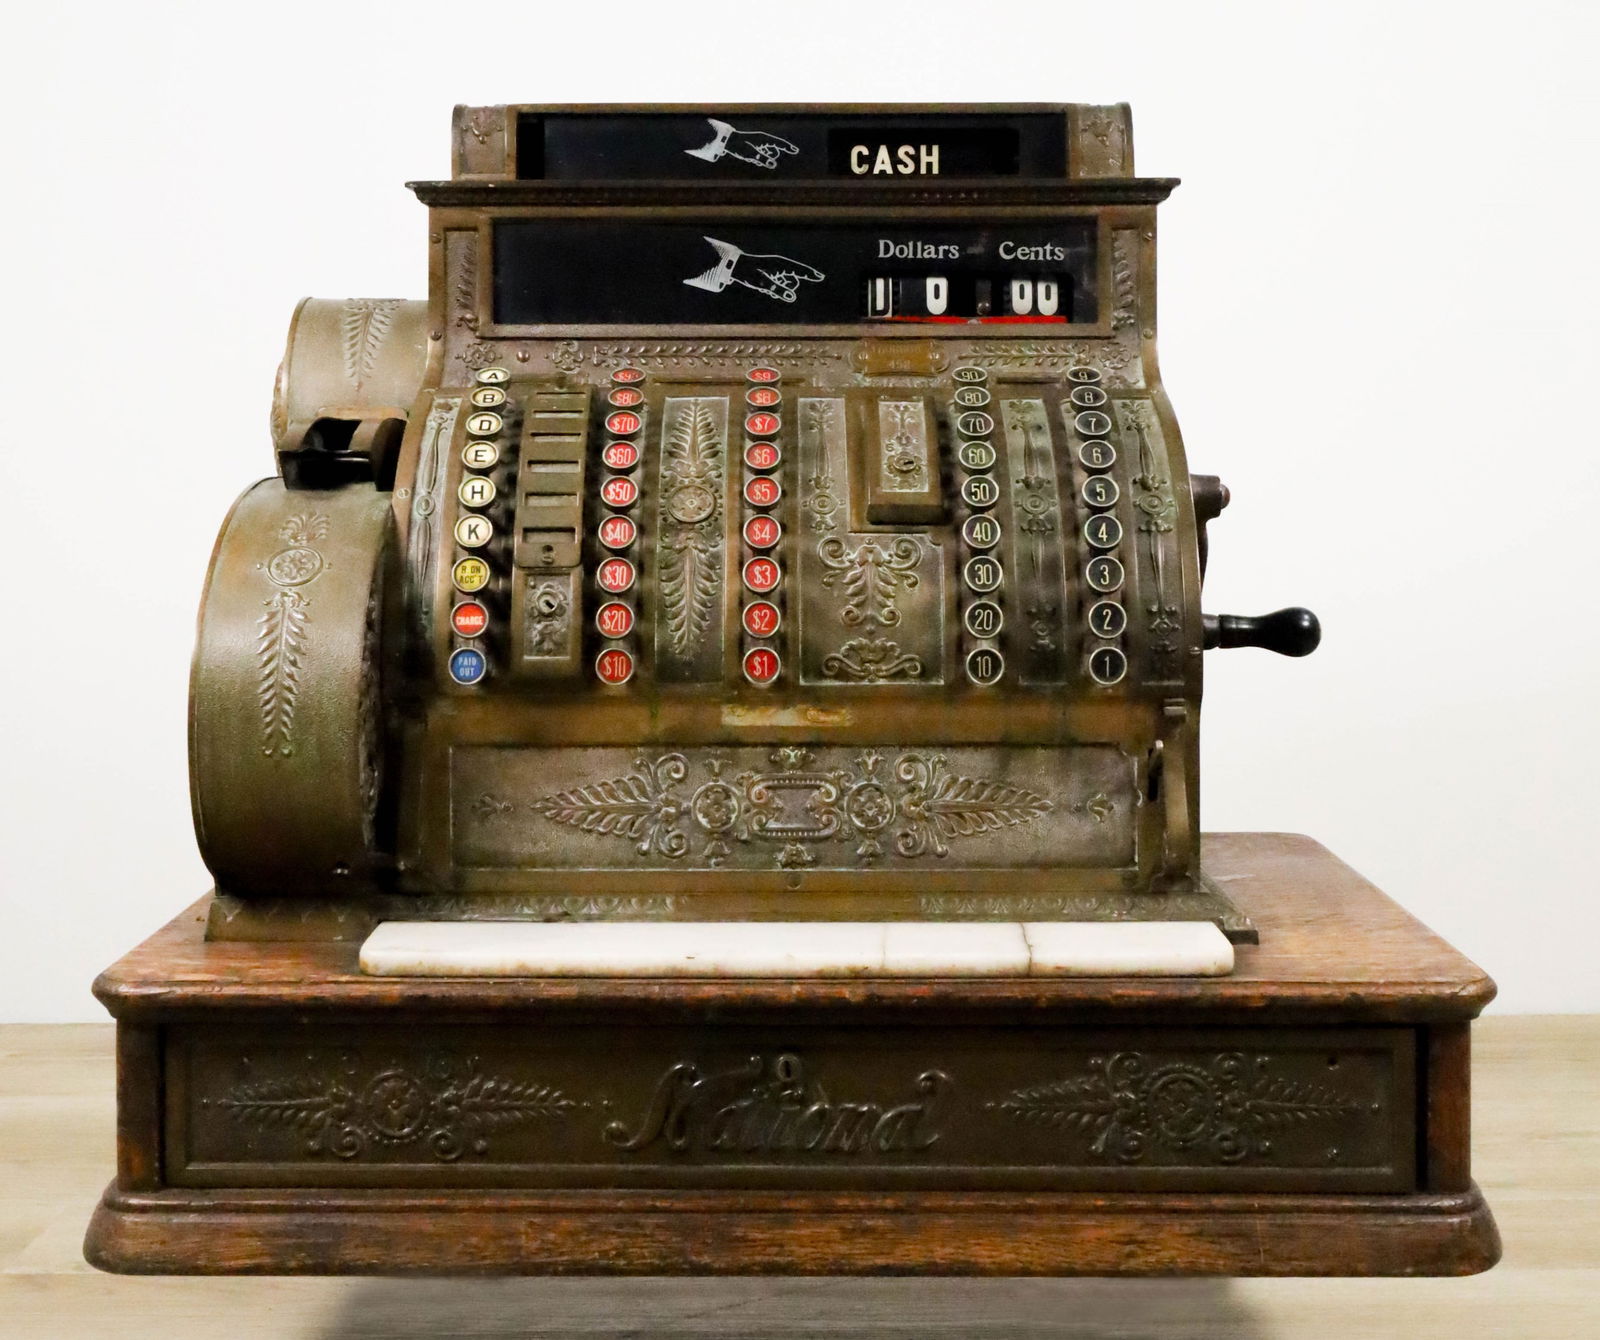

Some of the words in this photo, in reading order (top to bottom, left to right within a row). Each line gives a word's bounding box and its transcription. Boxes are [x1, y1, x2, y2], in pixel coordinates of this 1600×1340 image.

[850, 144, 940, 175] CASH
[878, 239, 960, 260] Dollars
[999, 241, 1065, 261] Cents
[488, 372, 499, 380] A
[961, 371, 979, 380] 90
[1079, 371, 1088, 380] 9
[482, 394, 495, 403] B
[755, 392, 771, 404] $8
[964, 392, 982, 404] 80
[1084, 392, 1093, 402] 8
[478, 419, 492, 431] D
[611, 417, 634, 431] $70
[754, 417, 770, 431] $7
[967, 418, 985, 432] 70
[1088, 418, 1097, 432] 7
[474, 450, 487, 462] E
[608, 448, 632, 465] $60
[753, 448, 770, 464] $6
[968, 448, 985, 465] 60
[1093, 448, 1101, 464] 6
[471, 485, 484, 500] H
[607, 484, 630, 501] $50
[753, 484, 770, 501] $5
[971, 483, 989, 501] 50
[1096, 483, 1105, 501] 5
[468, 523, 480, 540] K
[605, 522, 629, 542] $40
[753, 523, 771, 541] $4
[973, 522, 991, 542] 40
[1098, 522, 1108, 541] 4
[604, 565, 627, 586] $30
[753, 565, 770, 586] $3
[974, 564, 992, 585] 30
[1100, 564, 1109, 585] 3
[603, 609, 626, 631] $20
[752, 609, 770, 631] $2
[974, 609, 992, 630] 20
[1102, 609, 1112, 630] 2
[458, 657, 477, 666] PAID
[603, 655, 626, 677] $10
[753, 655, 769, 676] $1
[976, 656, 992, 677] 10
[1104, 656, 1110, 677] 1
[460, 667, 475, 676] OUT
